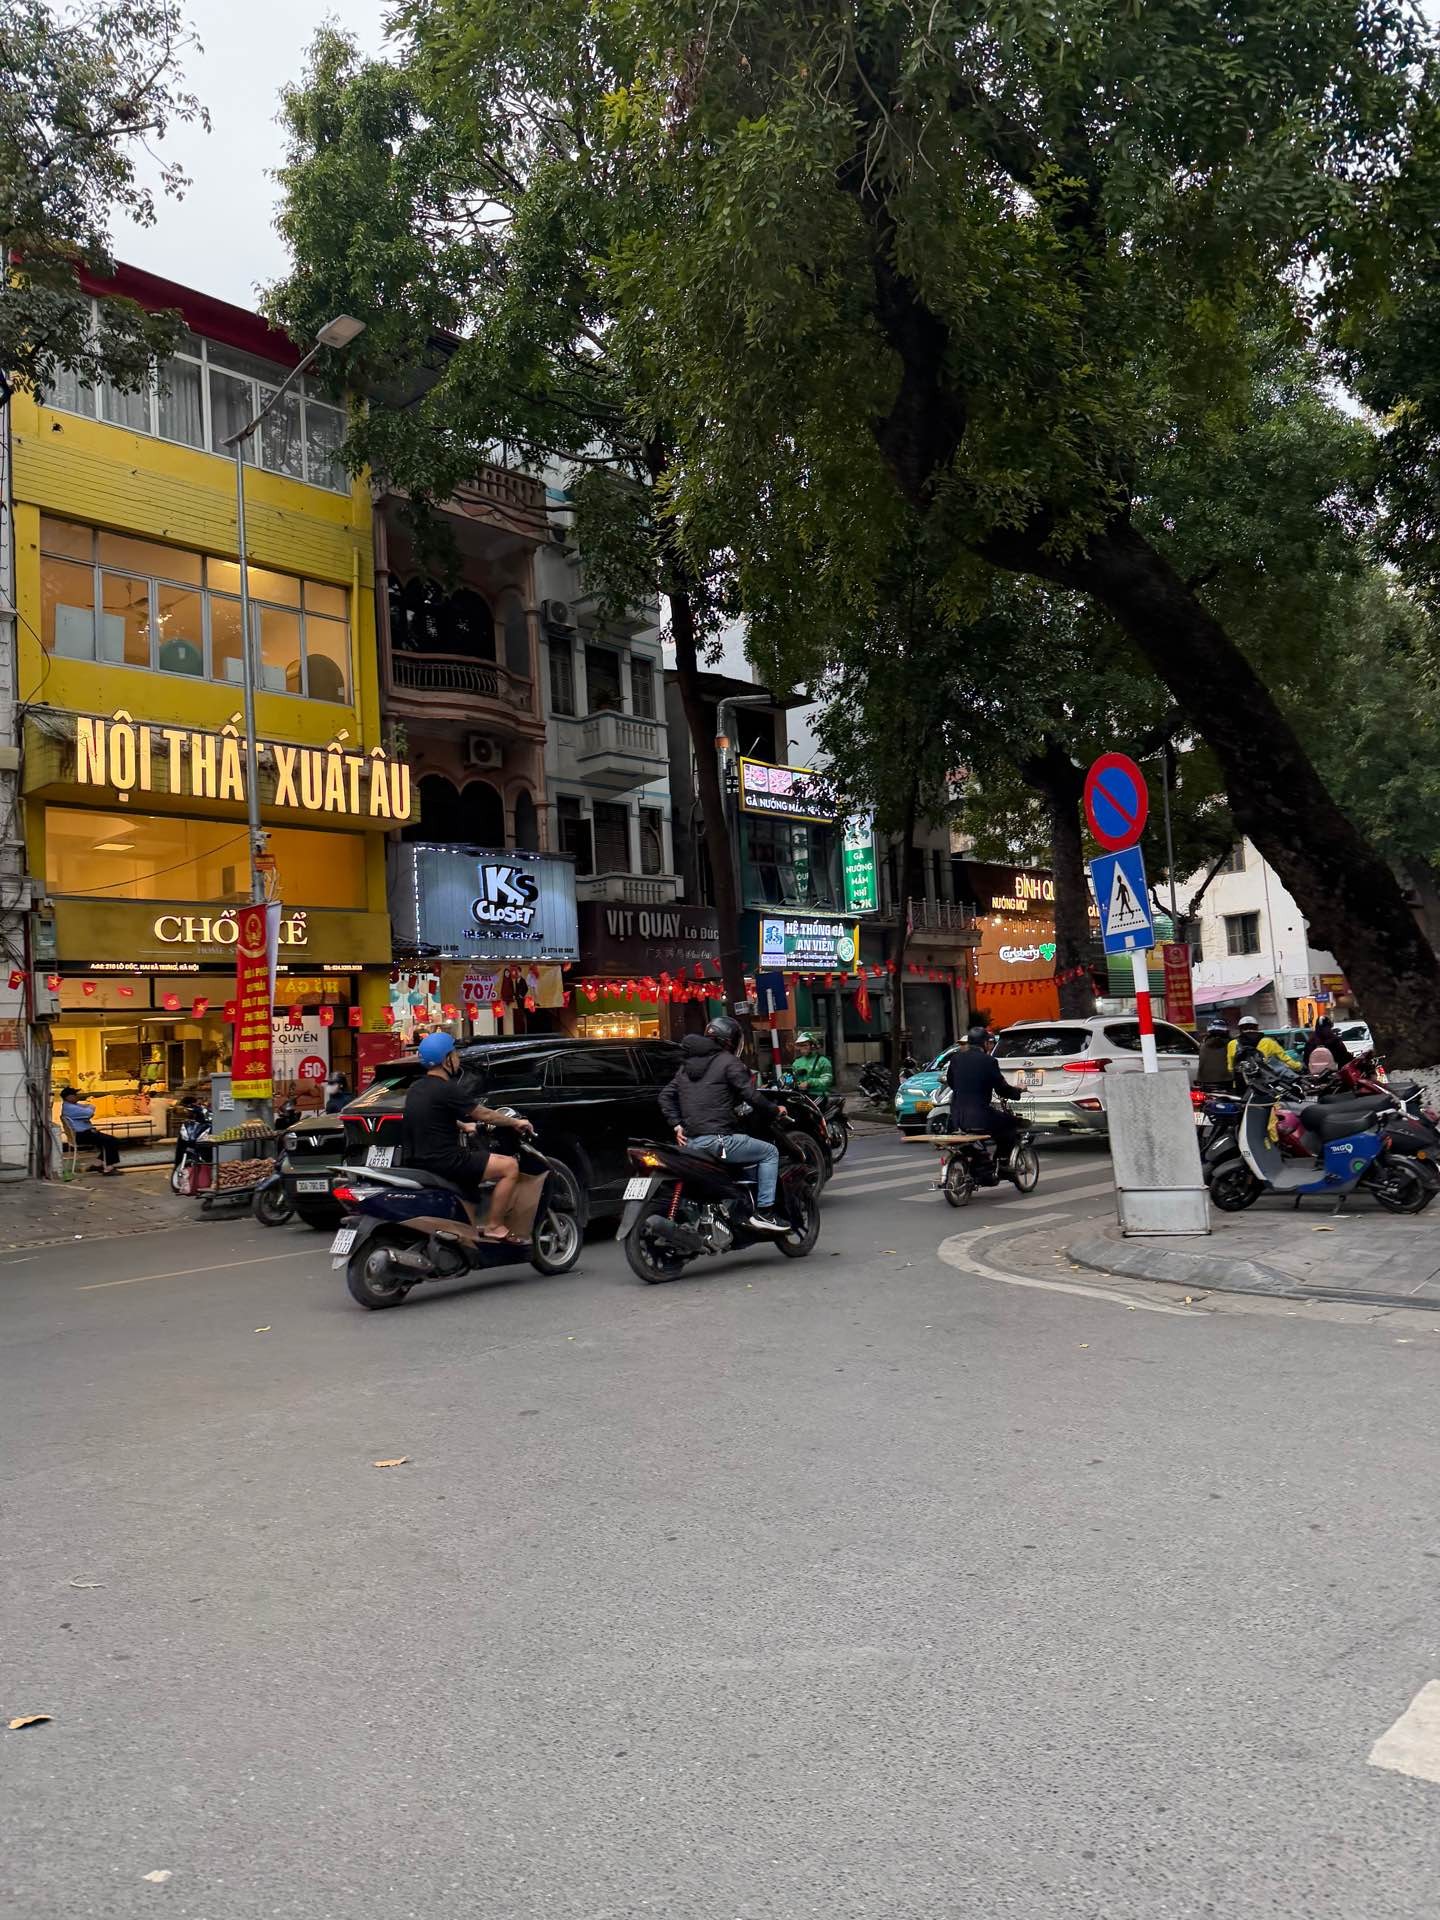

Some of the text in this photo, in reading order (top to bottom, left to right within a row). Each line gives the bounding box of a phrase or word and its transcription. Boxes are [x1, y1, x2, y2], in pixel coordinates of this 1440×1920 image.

[77, 709, 151, 802] NỘI
[275, 728, 364, 814] XUẤT
[369, 746, 411, 819] ÂU
[746, 794, 758, 806] GÀ
[606, 909, 634, 941] VỊT
[639, 911, 681, 940] QUAY
[1000, 945, 1040, 963] Carlsberg
[463, 983, 497, 1000] 70%
